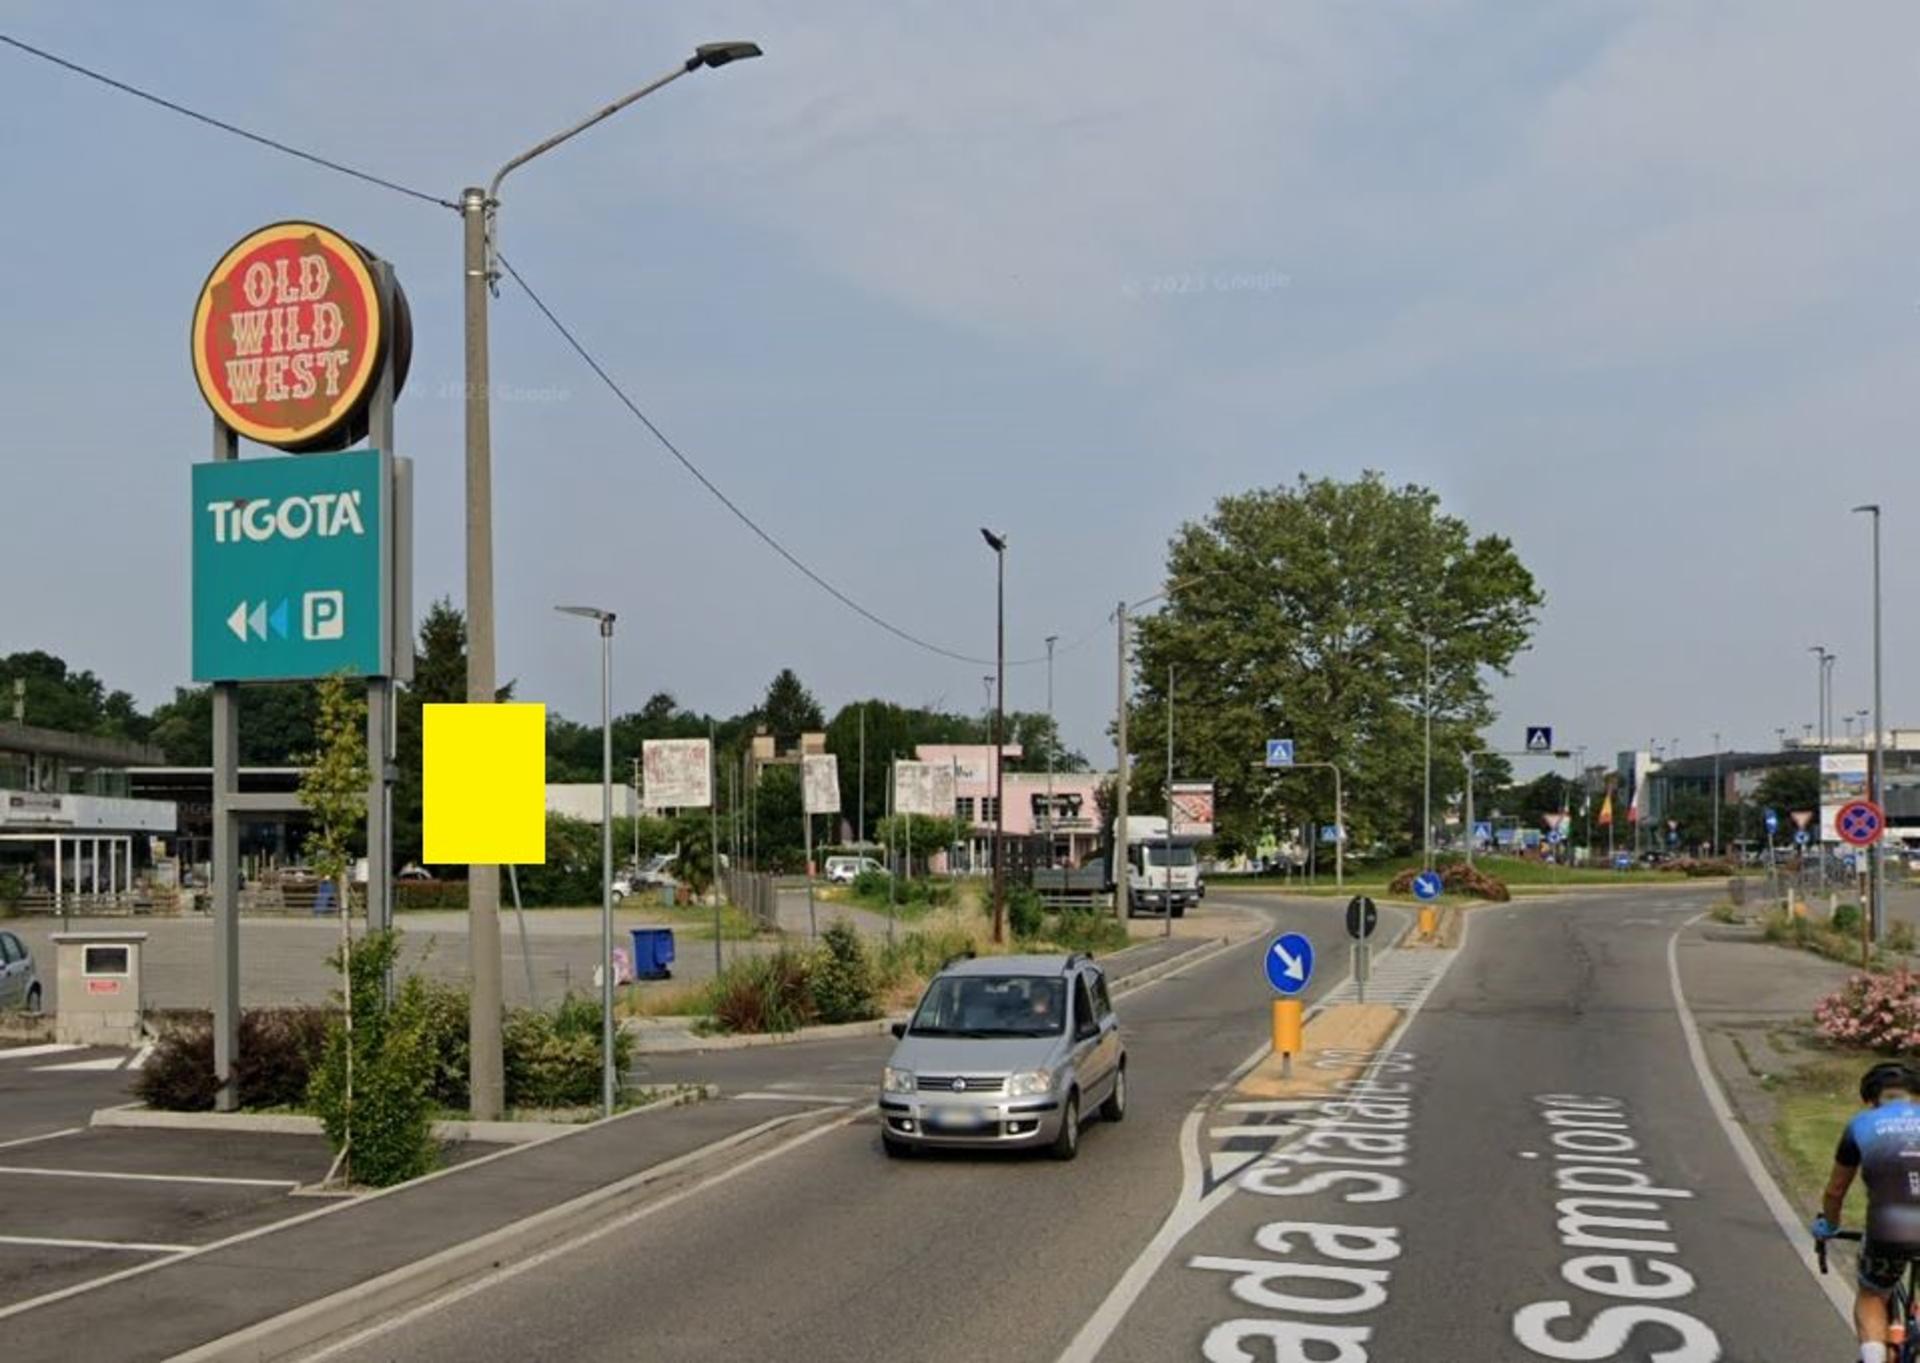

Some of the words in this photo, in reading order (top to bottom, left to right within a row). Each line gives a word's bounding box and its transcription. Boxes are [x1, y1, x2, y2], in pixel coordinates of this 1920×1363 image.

[243, 255, 330, 307] OLD
[230, 302, 343, 356] WILD
[225, 350, 349, 404] WEST
